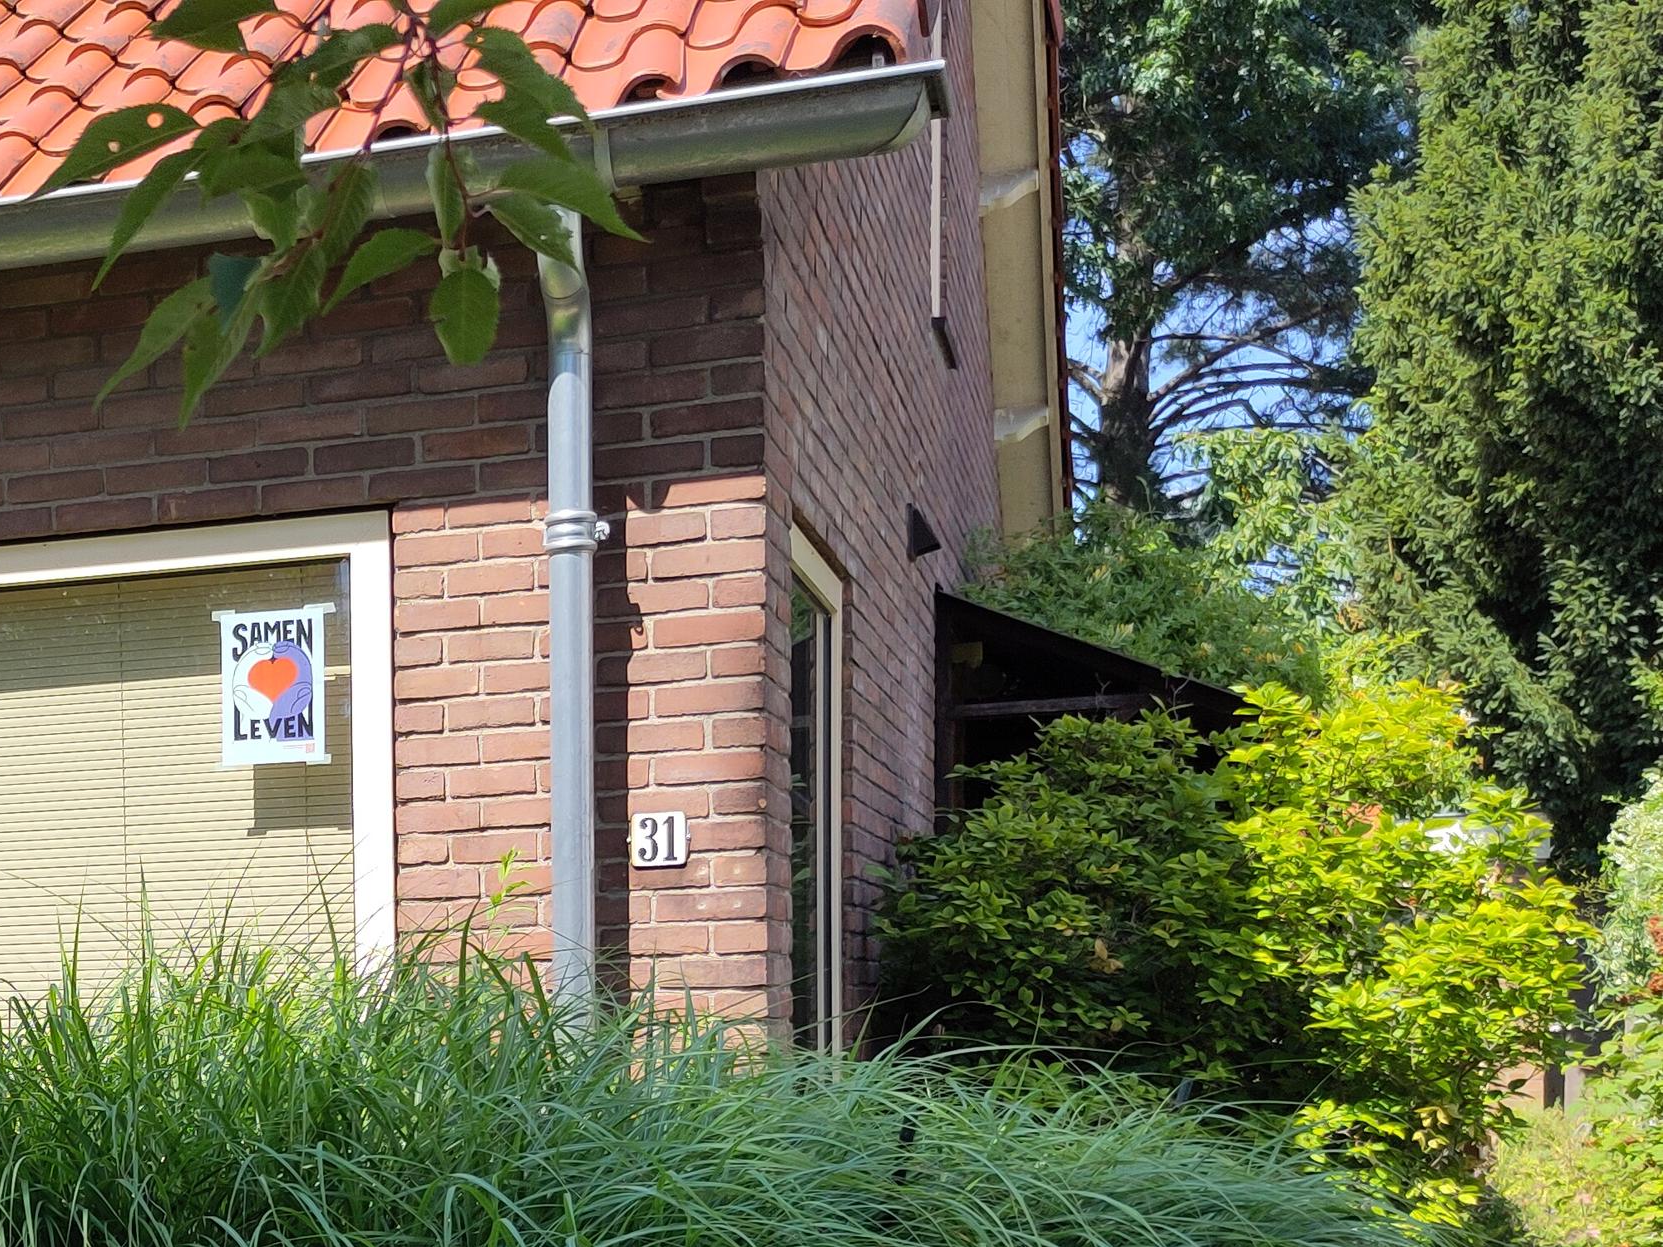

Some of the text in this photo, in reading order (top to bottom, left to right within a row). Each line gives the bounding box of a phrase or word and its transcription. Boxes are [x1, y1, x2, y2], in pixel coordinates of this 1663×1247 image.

[232, 618, 313, 663] SAMEN
[234, 702, 314, 741] LEVEN
[638, 816, 678, 862] 31
